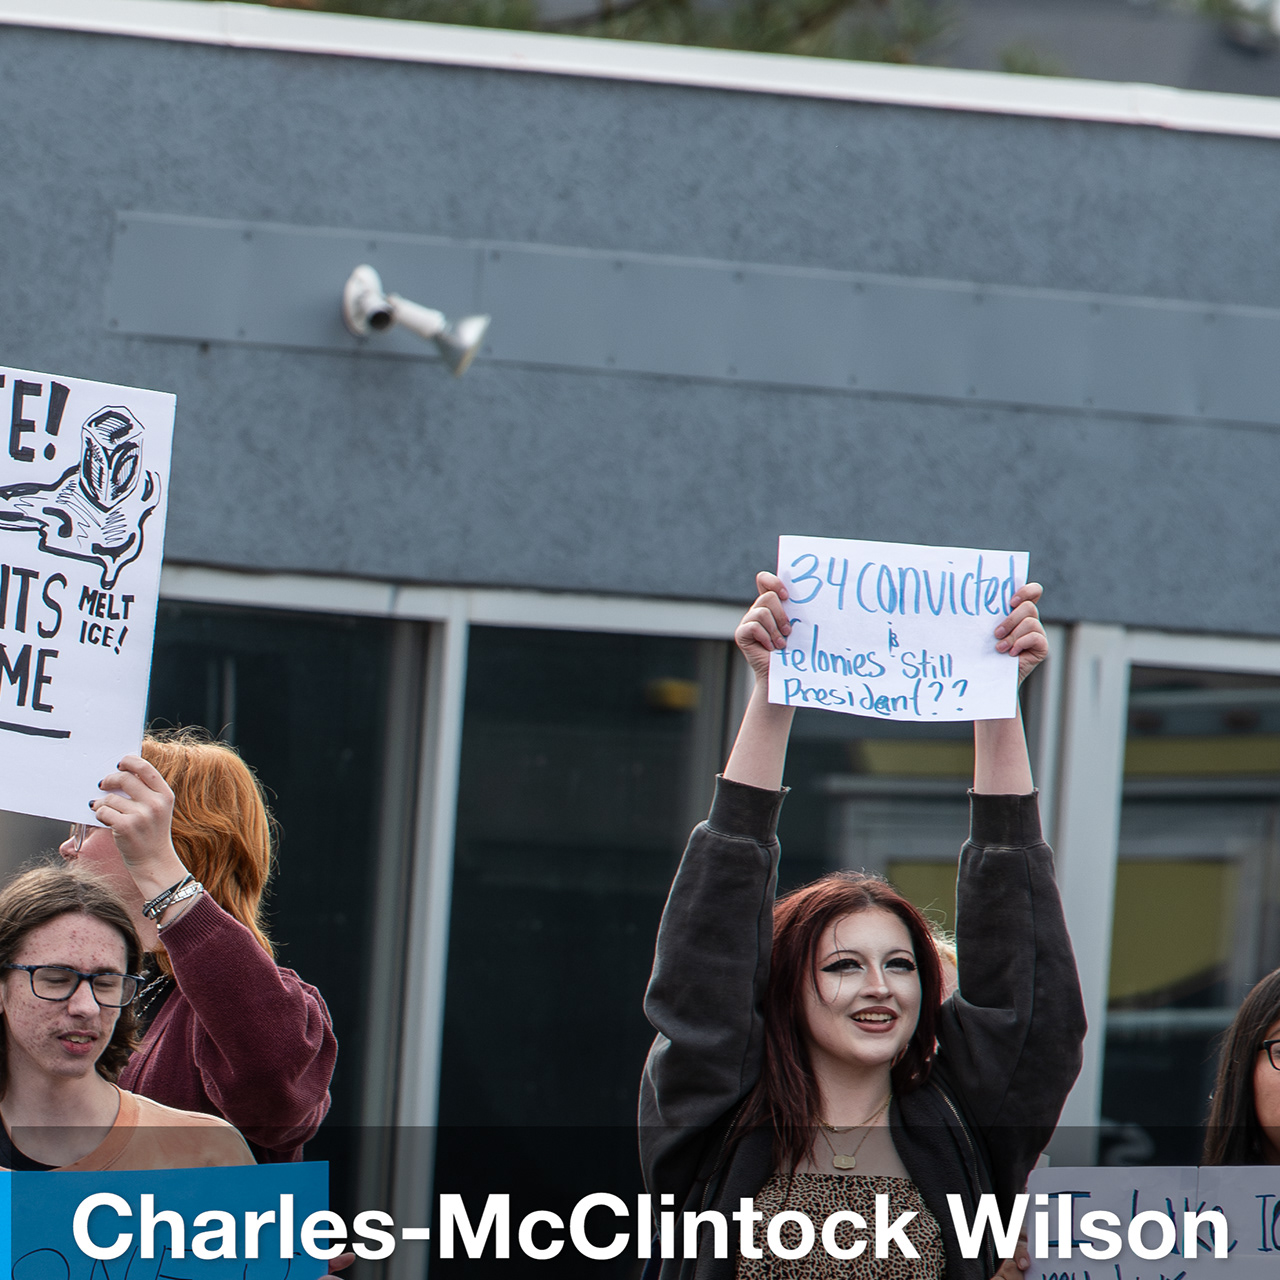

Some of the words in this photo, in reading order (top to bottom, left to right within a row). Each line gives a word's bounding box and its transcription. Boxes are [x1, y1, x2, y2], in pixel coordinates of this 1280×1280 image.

[788, 553, 849, 610] 34
[78, 585, 135, 620] MELT
[79, 620, 129, 655] ICE!
